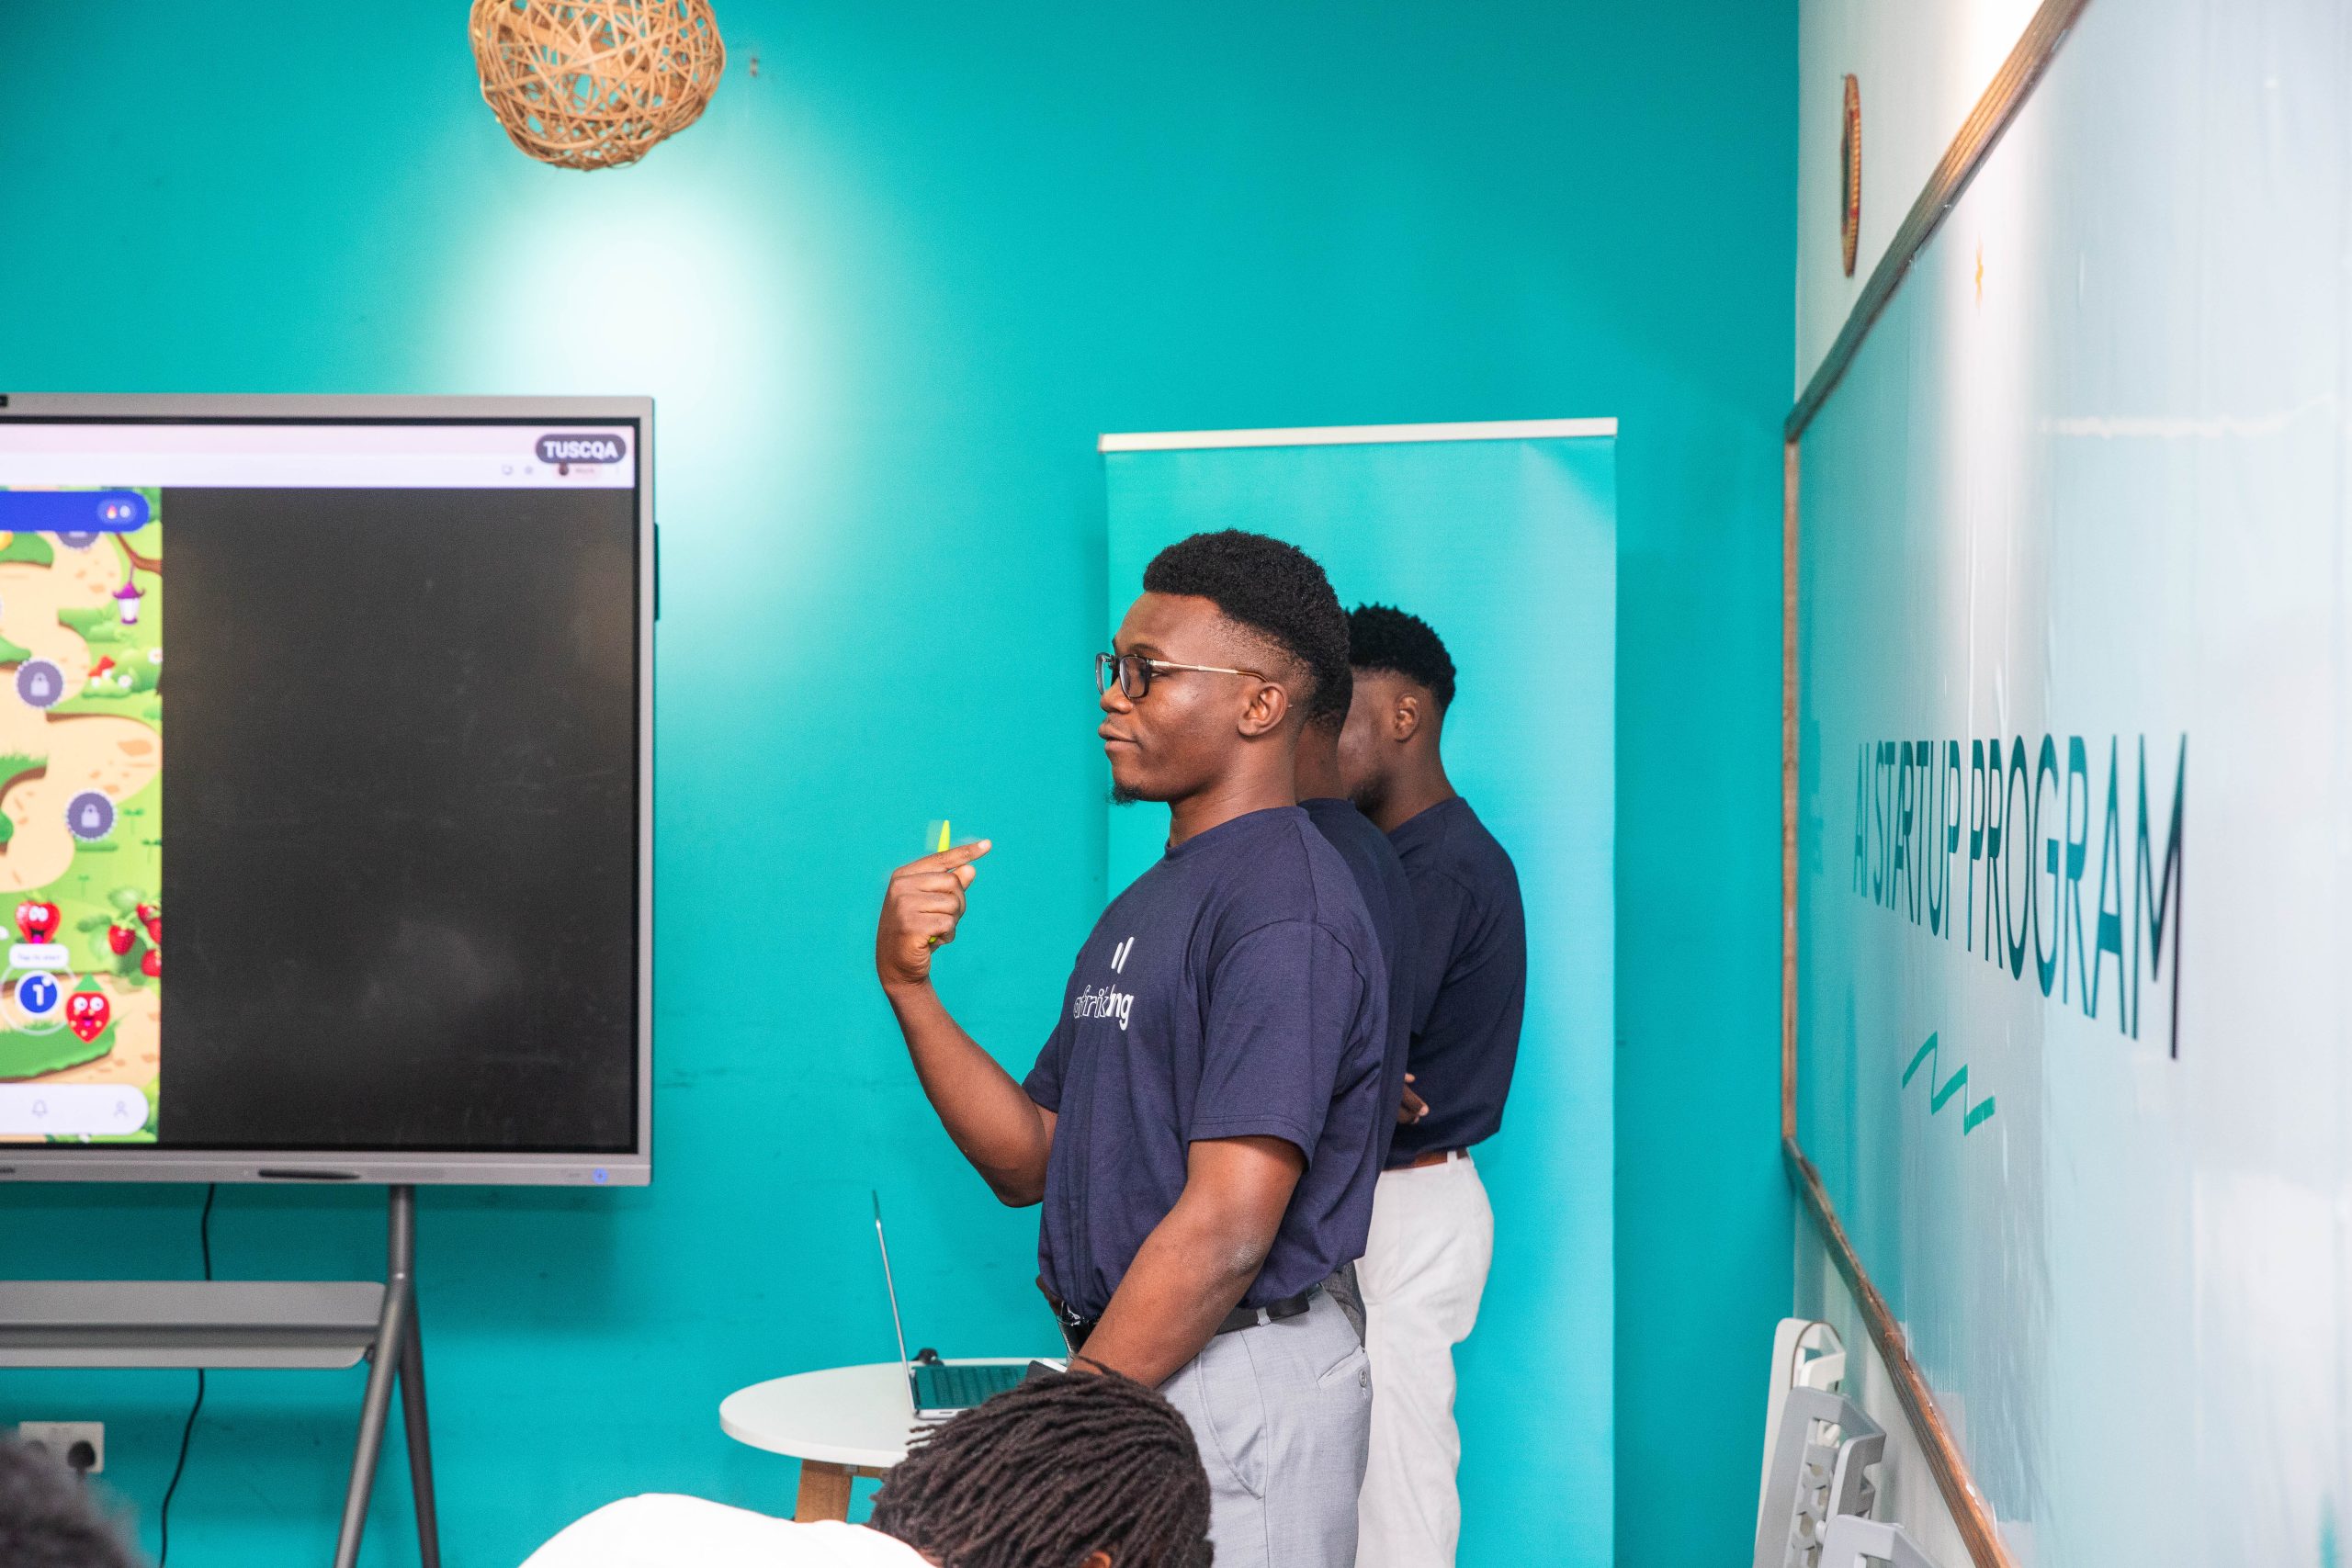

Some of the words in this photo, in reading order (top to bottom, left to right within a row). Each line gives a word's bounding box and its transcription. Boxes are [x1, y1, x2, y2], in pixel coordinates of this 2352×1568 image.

[1853, 742, 1869, 898] AI
[1873, 739, 1961, 940] STARTUP
[1968, 732, 2187, 1061] PROGRAM
[32, 984, 45, 1006] 1
